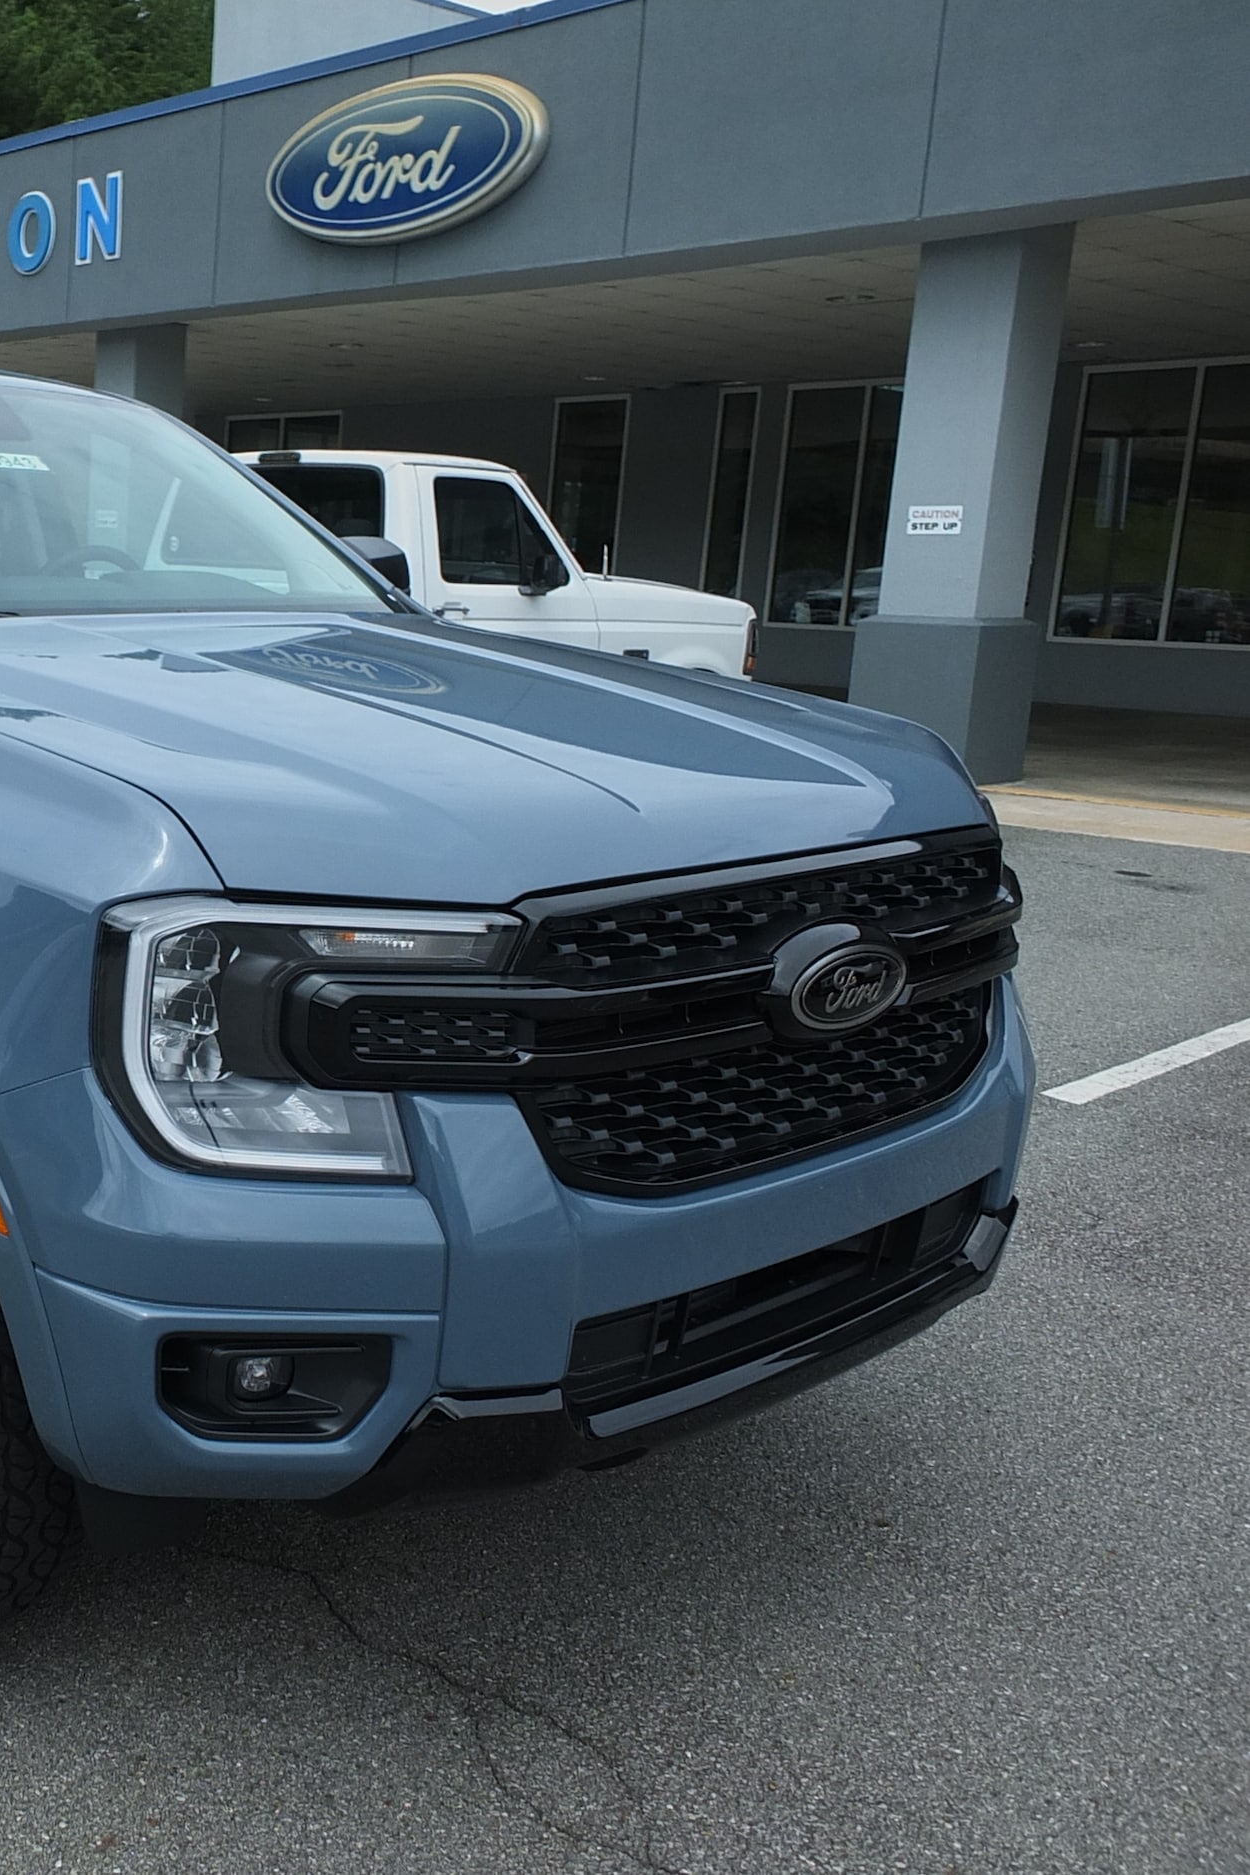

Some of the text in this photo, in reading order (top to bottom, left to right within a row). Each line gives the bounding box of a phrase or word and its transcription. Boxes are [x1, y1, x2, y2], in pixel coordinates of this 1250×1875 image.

[313, 115, 461, 212] Ford
[911, 510, 959, 519] CAUTION
[911, 522, 958, 531] STEP UP
[825, 961, 887, 1013] Ford
